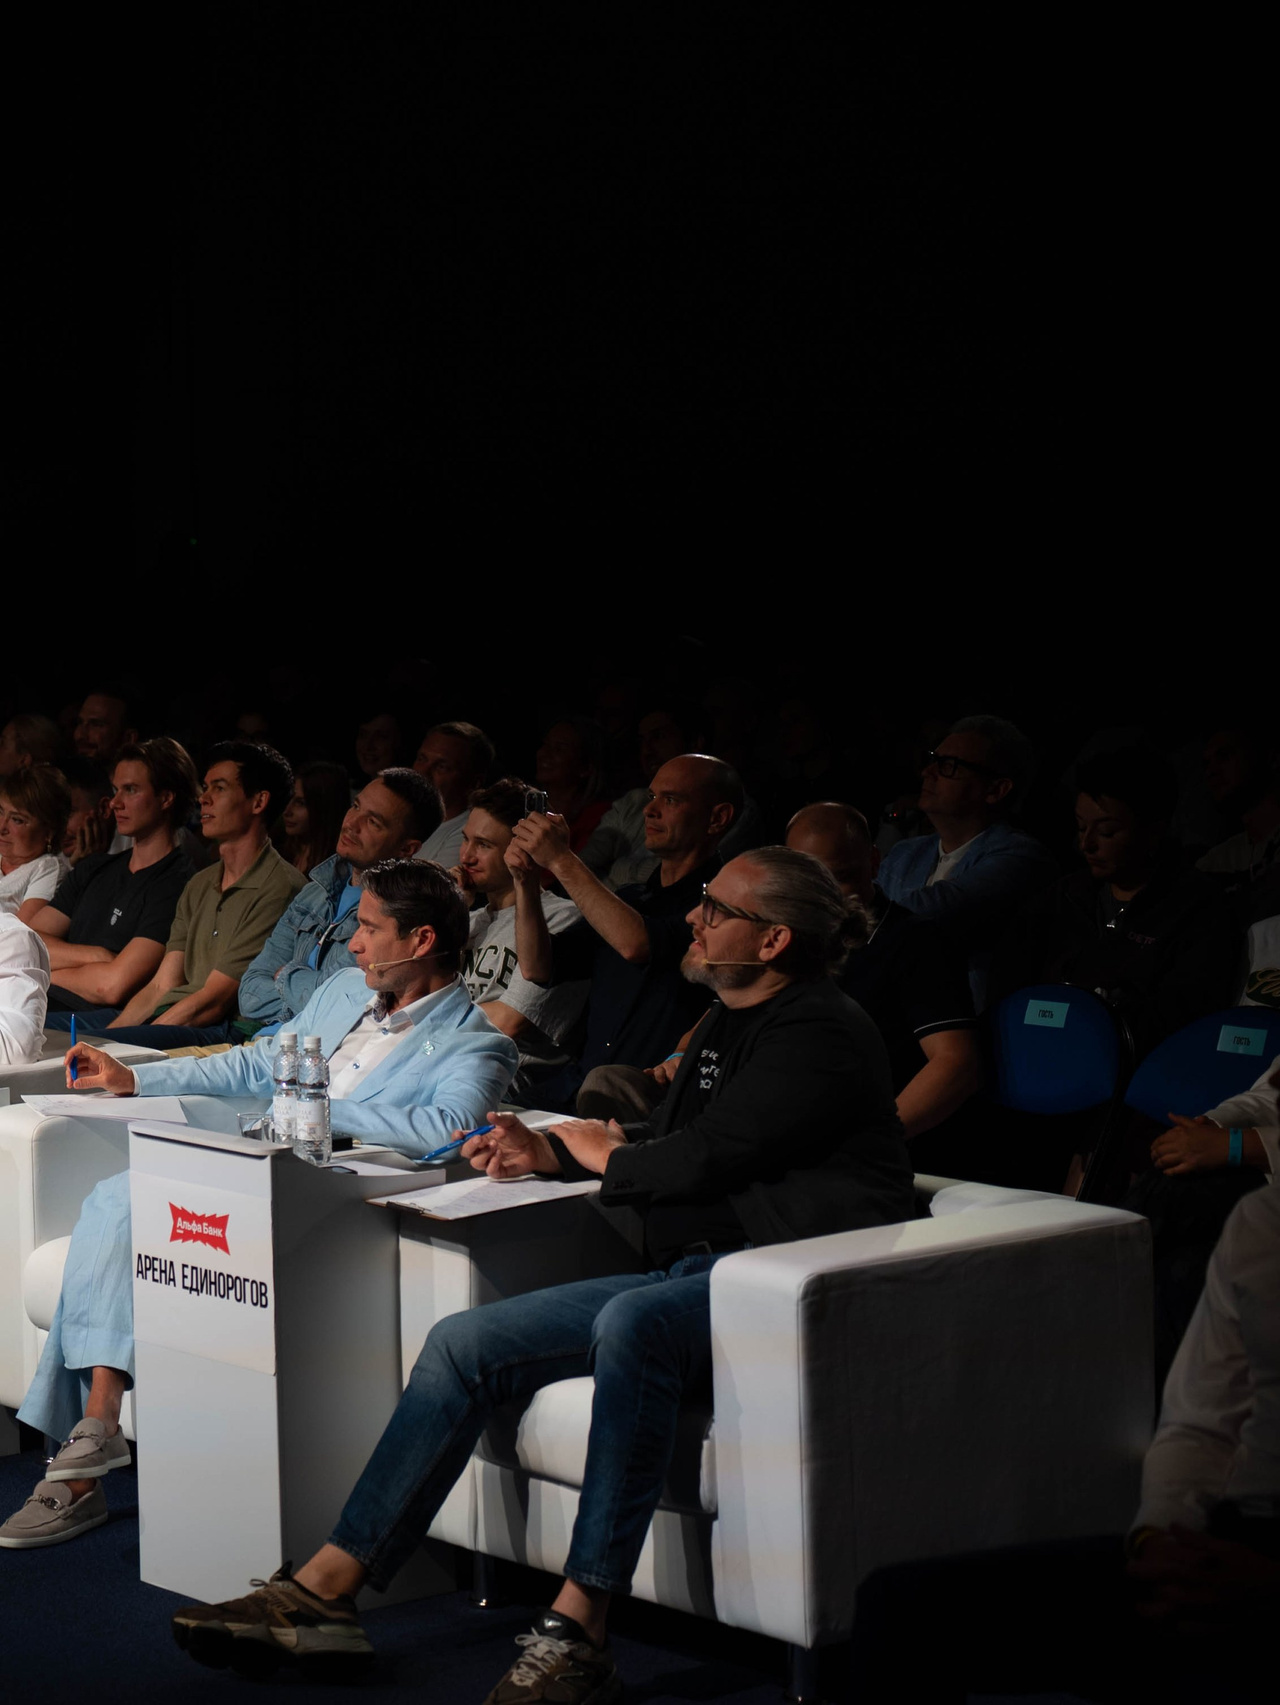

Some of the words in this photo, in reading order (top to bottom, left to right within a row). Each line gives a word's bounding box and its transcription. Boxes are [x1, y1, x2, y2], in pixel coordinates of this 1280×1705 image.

[176, 1216, 202, 1235] Альфа
[203, 1222, 223, 1238] Банк
[136, 1253, 176, 1287] АРЕНА
[181, 1263, 268, 1308] ЕДИНОРОГОВ
